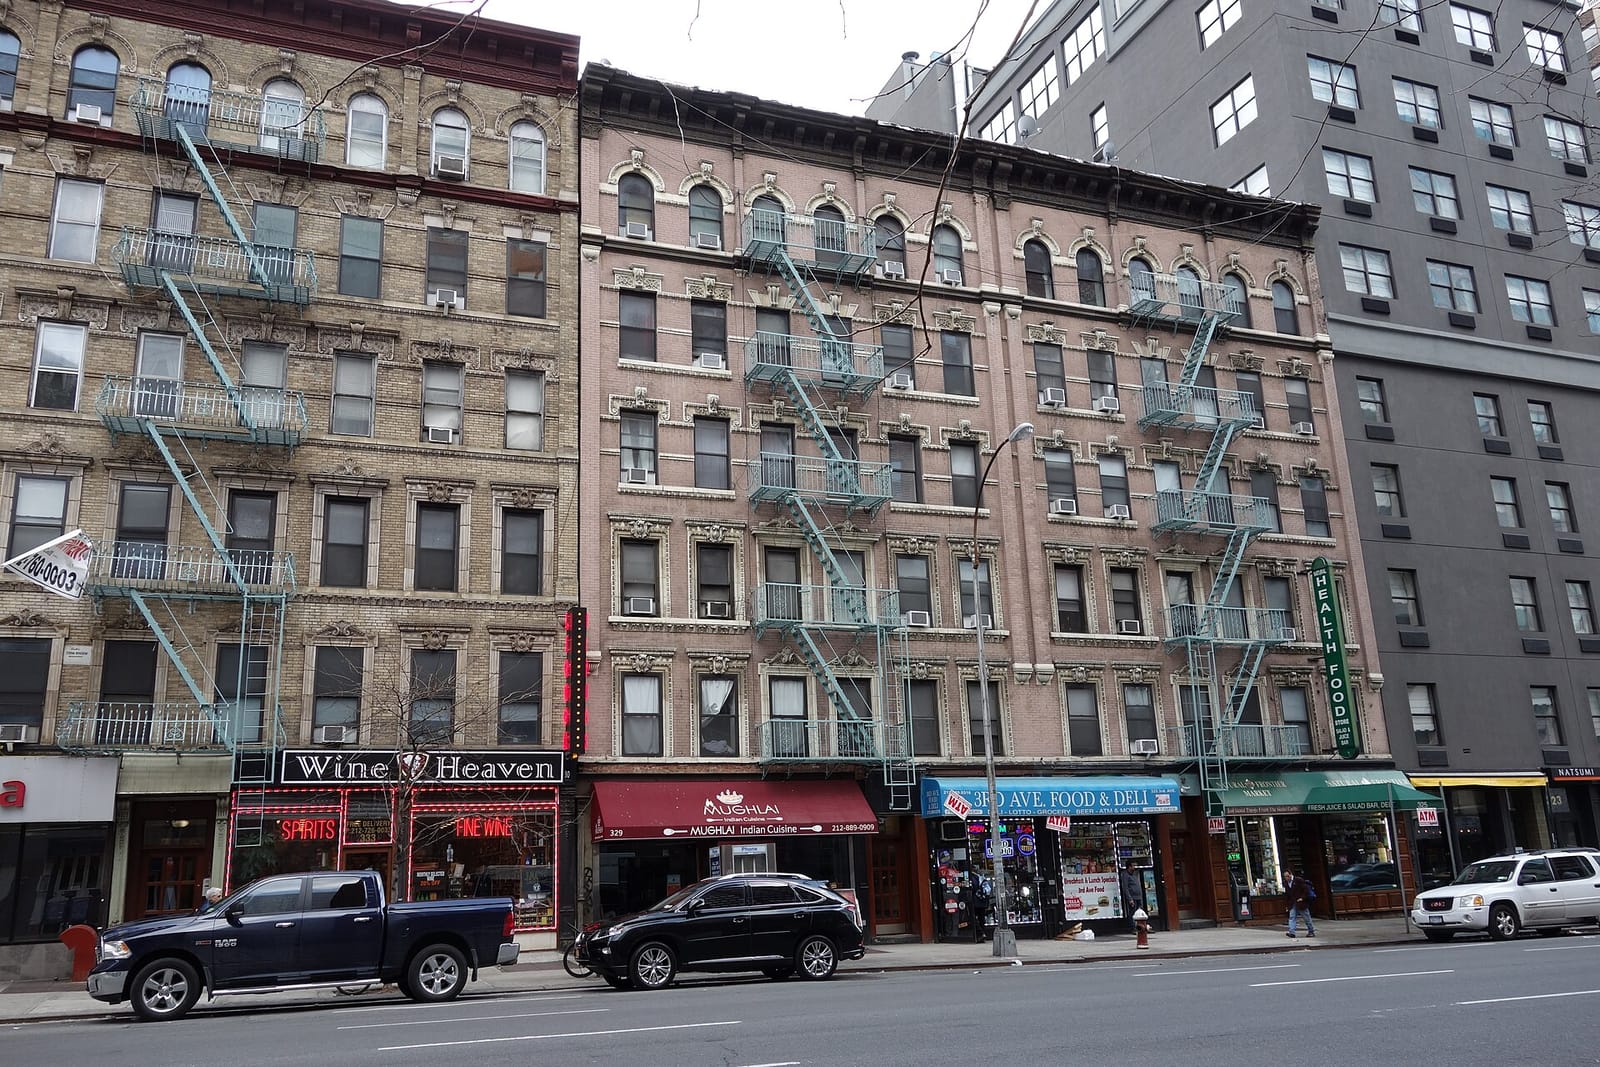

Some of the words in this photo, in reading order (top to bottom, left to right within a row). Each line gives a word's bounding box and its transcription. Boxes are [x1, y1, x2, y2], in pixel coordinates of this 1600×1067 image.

[1315, 575, 1337, 654] HEALTH
[1329, 664, 1346, 717] FOOD
[296, 755, 388, 779] Wine
[436, 755, 554, 779] Heaven
[1558, 768, 1594, 776] NATSUMI
[1010, 790, 1045, 808] AVE.
[1050, 790, 1096, 807] FOOD
[1100, 791, 1111, 807] &
[1114, 789, 1149, 806] DELI
[703, 804, 780, 815] MUGHLAI
[948, 795, 968, 815] ATM
[1307, 803, 1326, 811] FRESH
[1348, 802, 1366, 810] SALAD
[1047, 816, 1069, 828] ATM
[1419, 811, 1437, 822] ATM
[281, 819, 336, 840] SPIRITS
[456, 818, 481, 837] FINE
[484, 817, 513, 836] WINE
[690, 825, 735, 835] MUGHLAI
[740, 825, 766, 835] Indian
[767, 824, 798, 834] Cuisine
[831, 823, 875, 832] 212-889-0909
[1209, 819, 1224, 829] ATM
[609, 829, 623, 837] 329
